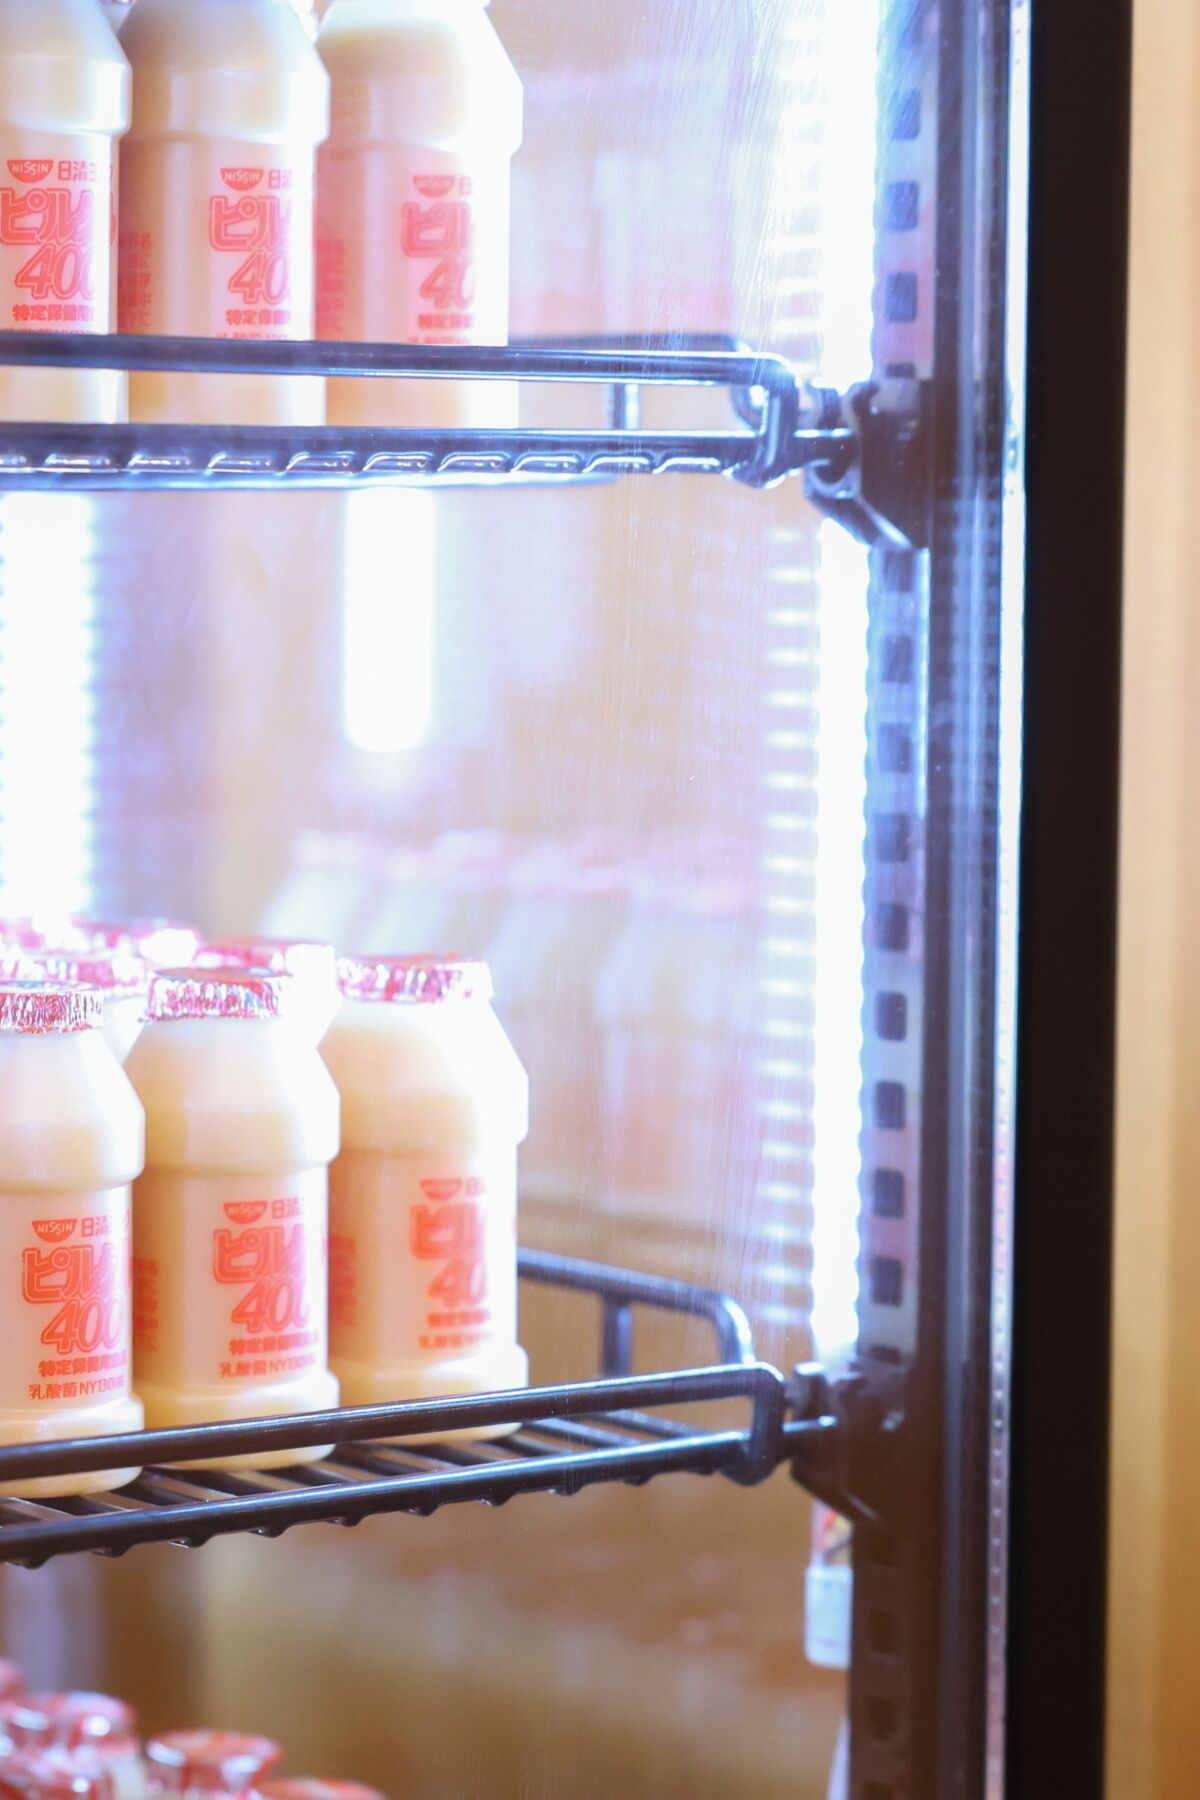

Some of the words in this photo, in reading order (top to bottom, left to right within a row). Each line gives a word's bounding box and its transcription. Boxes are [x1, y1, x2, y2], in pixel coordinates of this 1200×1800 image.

[209, 195, 290, 252] ピル
[12, 303, 93, 322] 特定保健用
[41, 1299, 120, 1355] 400
